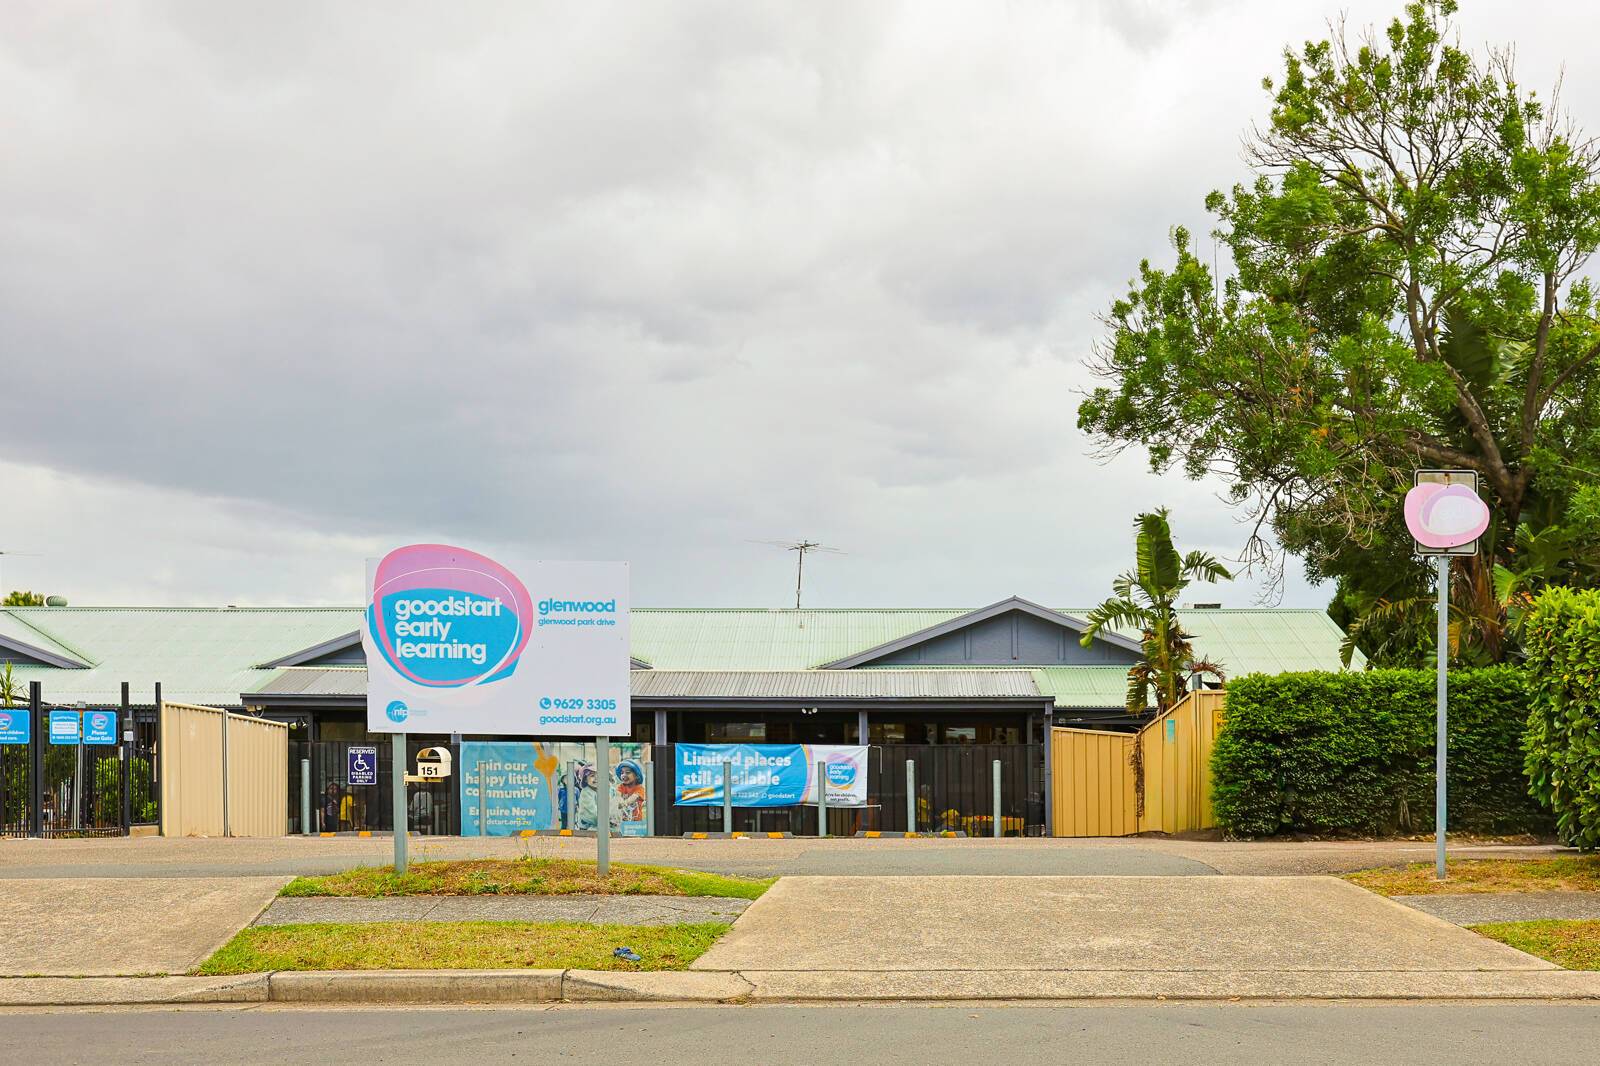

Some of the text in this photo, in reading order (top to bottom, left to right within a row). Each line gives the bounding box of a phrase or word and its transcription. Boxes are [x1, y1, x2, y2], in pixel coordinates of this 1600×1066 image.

[394, 596, 502, 620] goodstart
[538, 598, 615, 615] glenwood
[538, 618, 615, 626] glenwood park drive
[394, 617, 452, 641] early
[396, 638, 486, 665] learning
[553, 698, 616, 710] 9629 3305
[539, 715, 616, 726] goodstart.org.au
[683, 751, 792, 769] Limited places
[421, 766, 438, 776] 151
[504, 762, 528, 772] our
[508, 772, 540, 785] little
[683, 770, 780, 786] still aailable
[511, 807, 536, 817] Now
